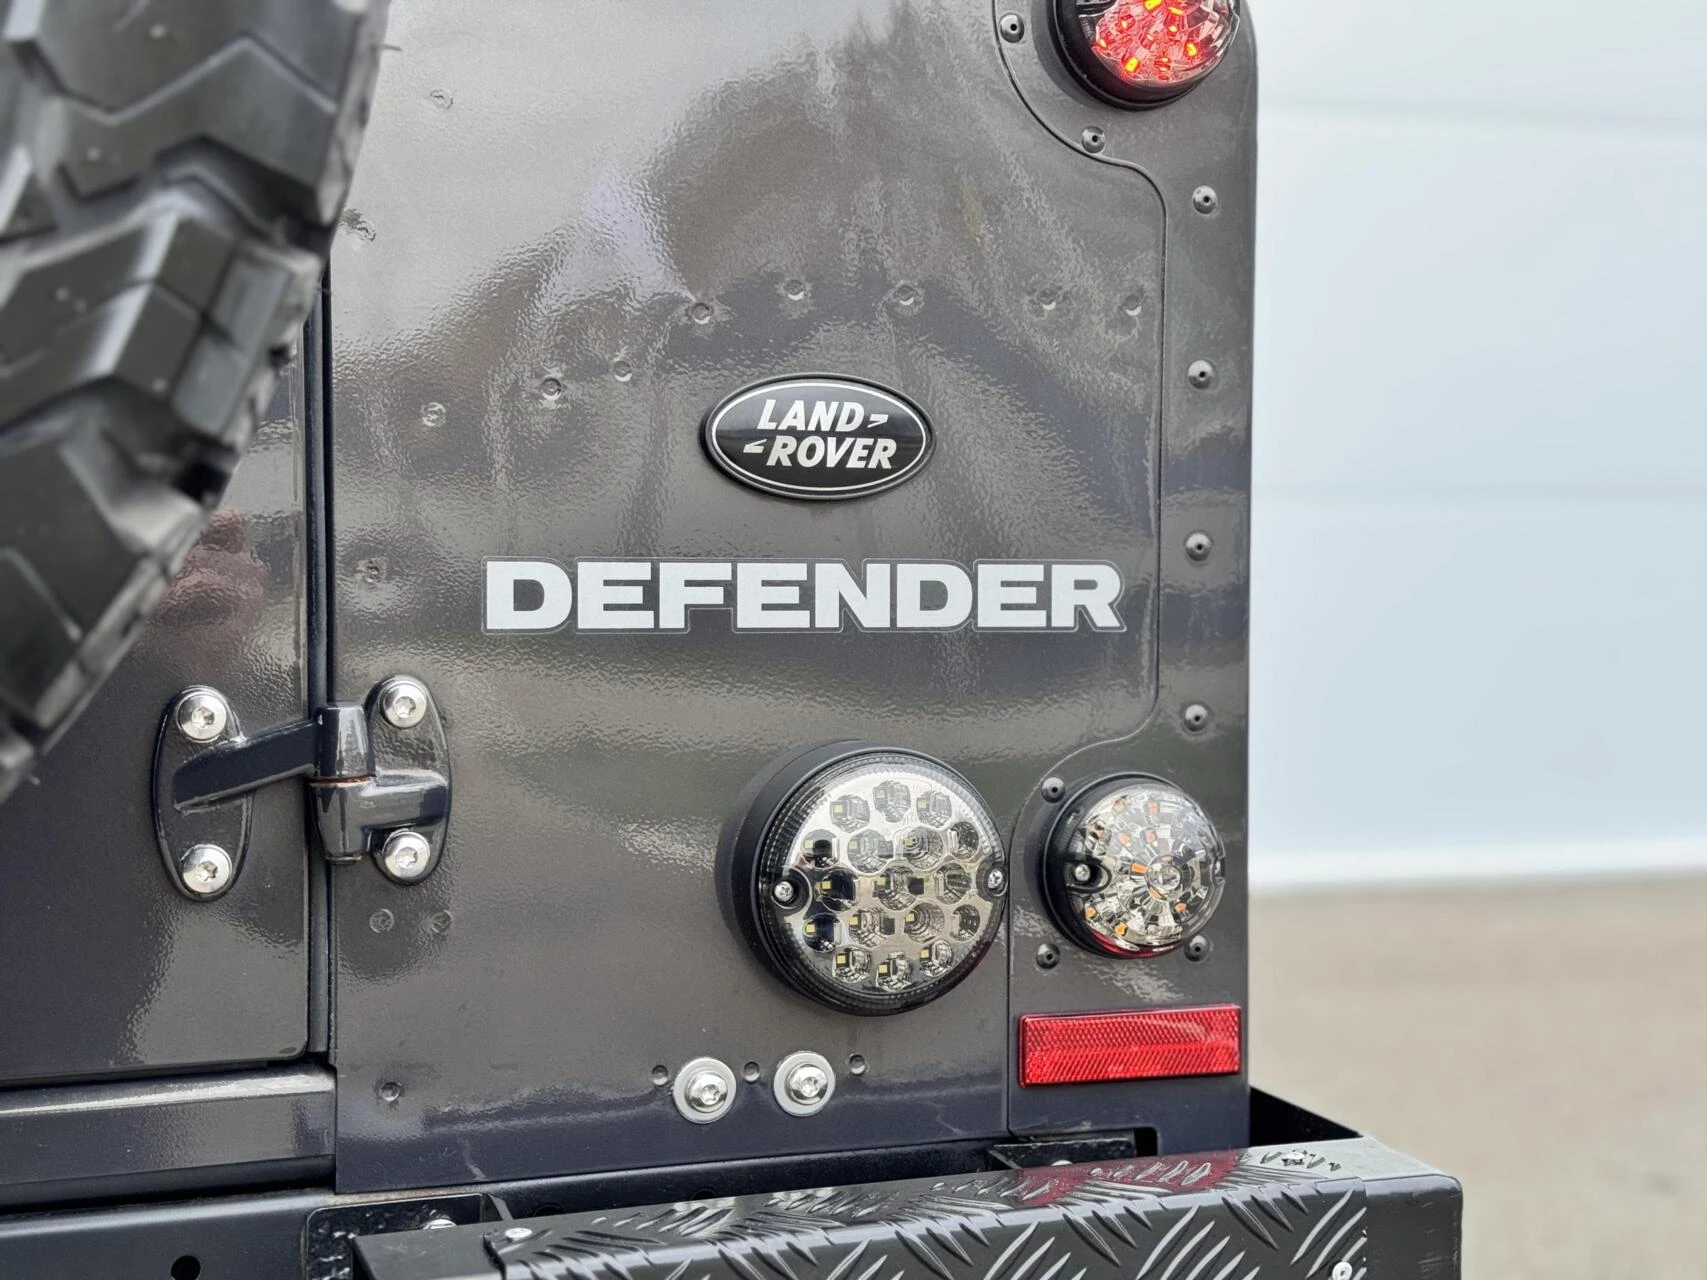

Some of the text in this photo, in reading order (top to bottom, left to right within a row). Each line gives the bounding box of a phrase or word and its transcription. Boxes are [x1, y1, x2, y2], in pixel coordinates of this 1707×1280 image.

[757, 399, 865, 432] LAND
[766, 435, 897, 469] ROVER
[486, 561, 1121, 629] DEFENDER
